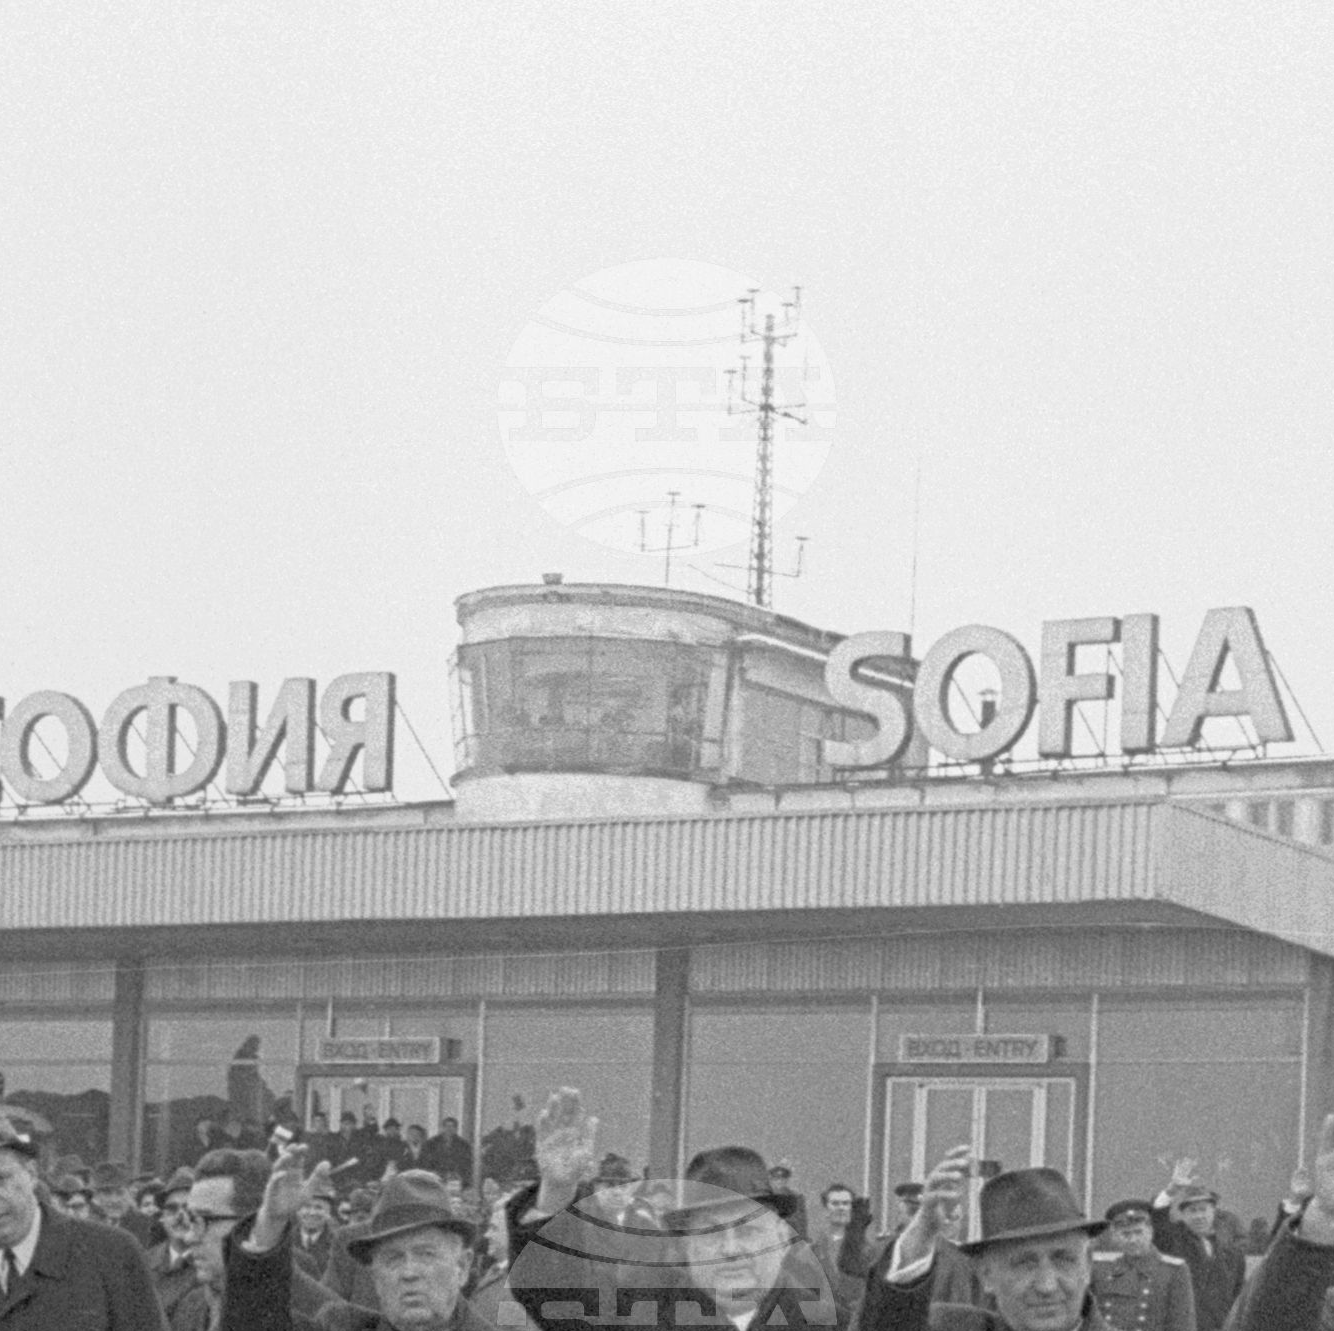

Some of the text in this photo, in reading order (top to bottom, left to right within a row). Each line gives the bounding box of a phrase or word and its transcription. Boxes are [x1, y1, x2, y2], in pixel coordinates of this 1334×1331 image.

[824, 606, 1295, 768] SOFIA
[378, 1041, 431, 1059] ENTRY
[908, 1039, 1038, 1058] ВХОД ENTRY
